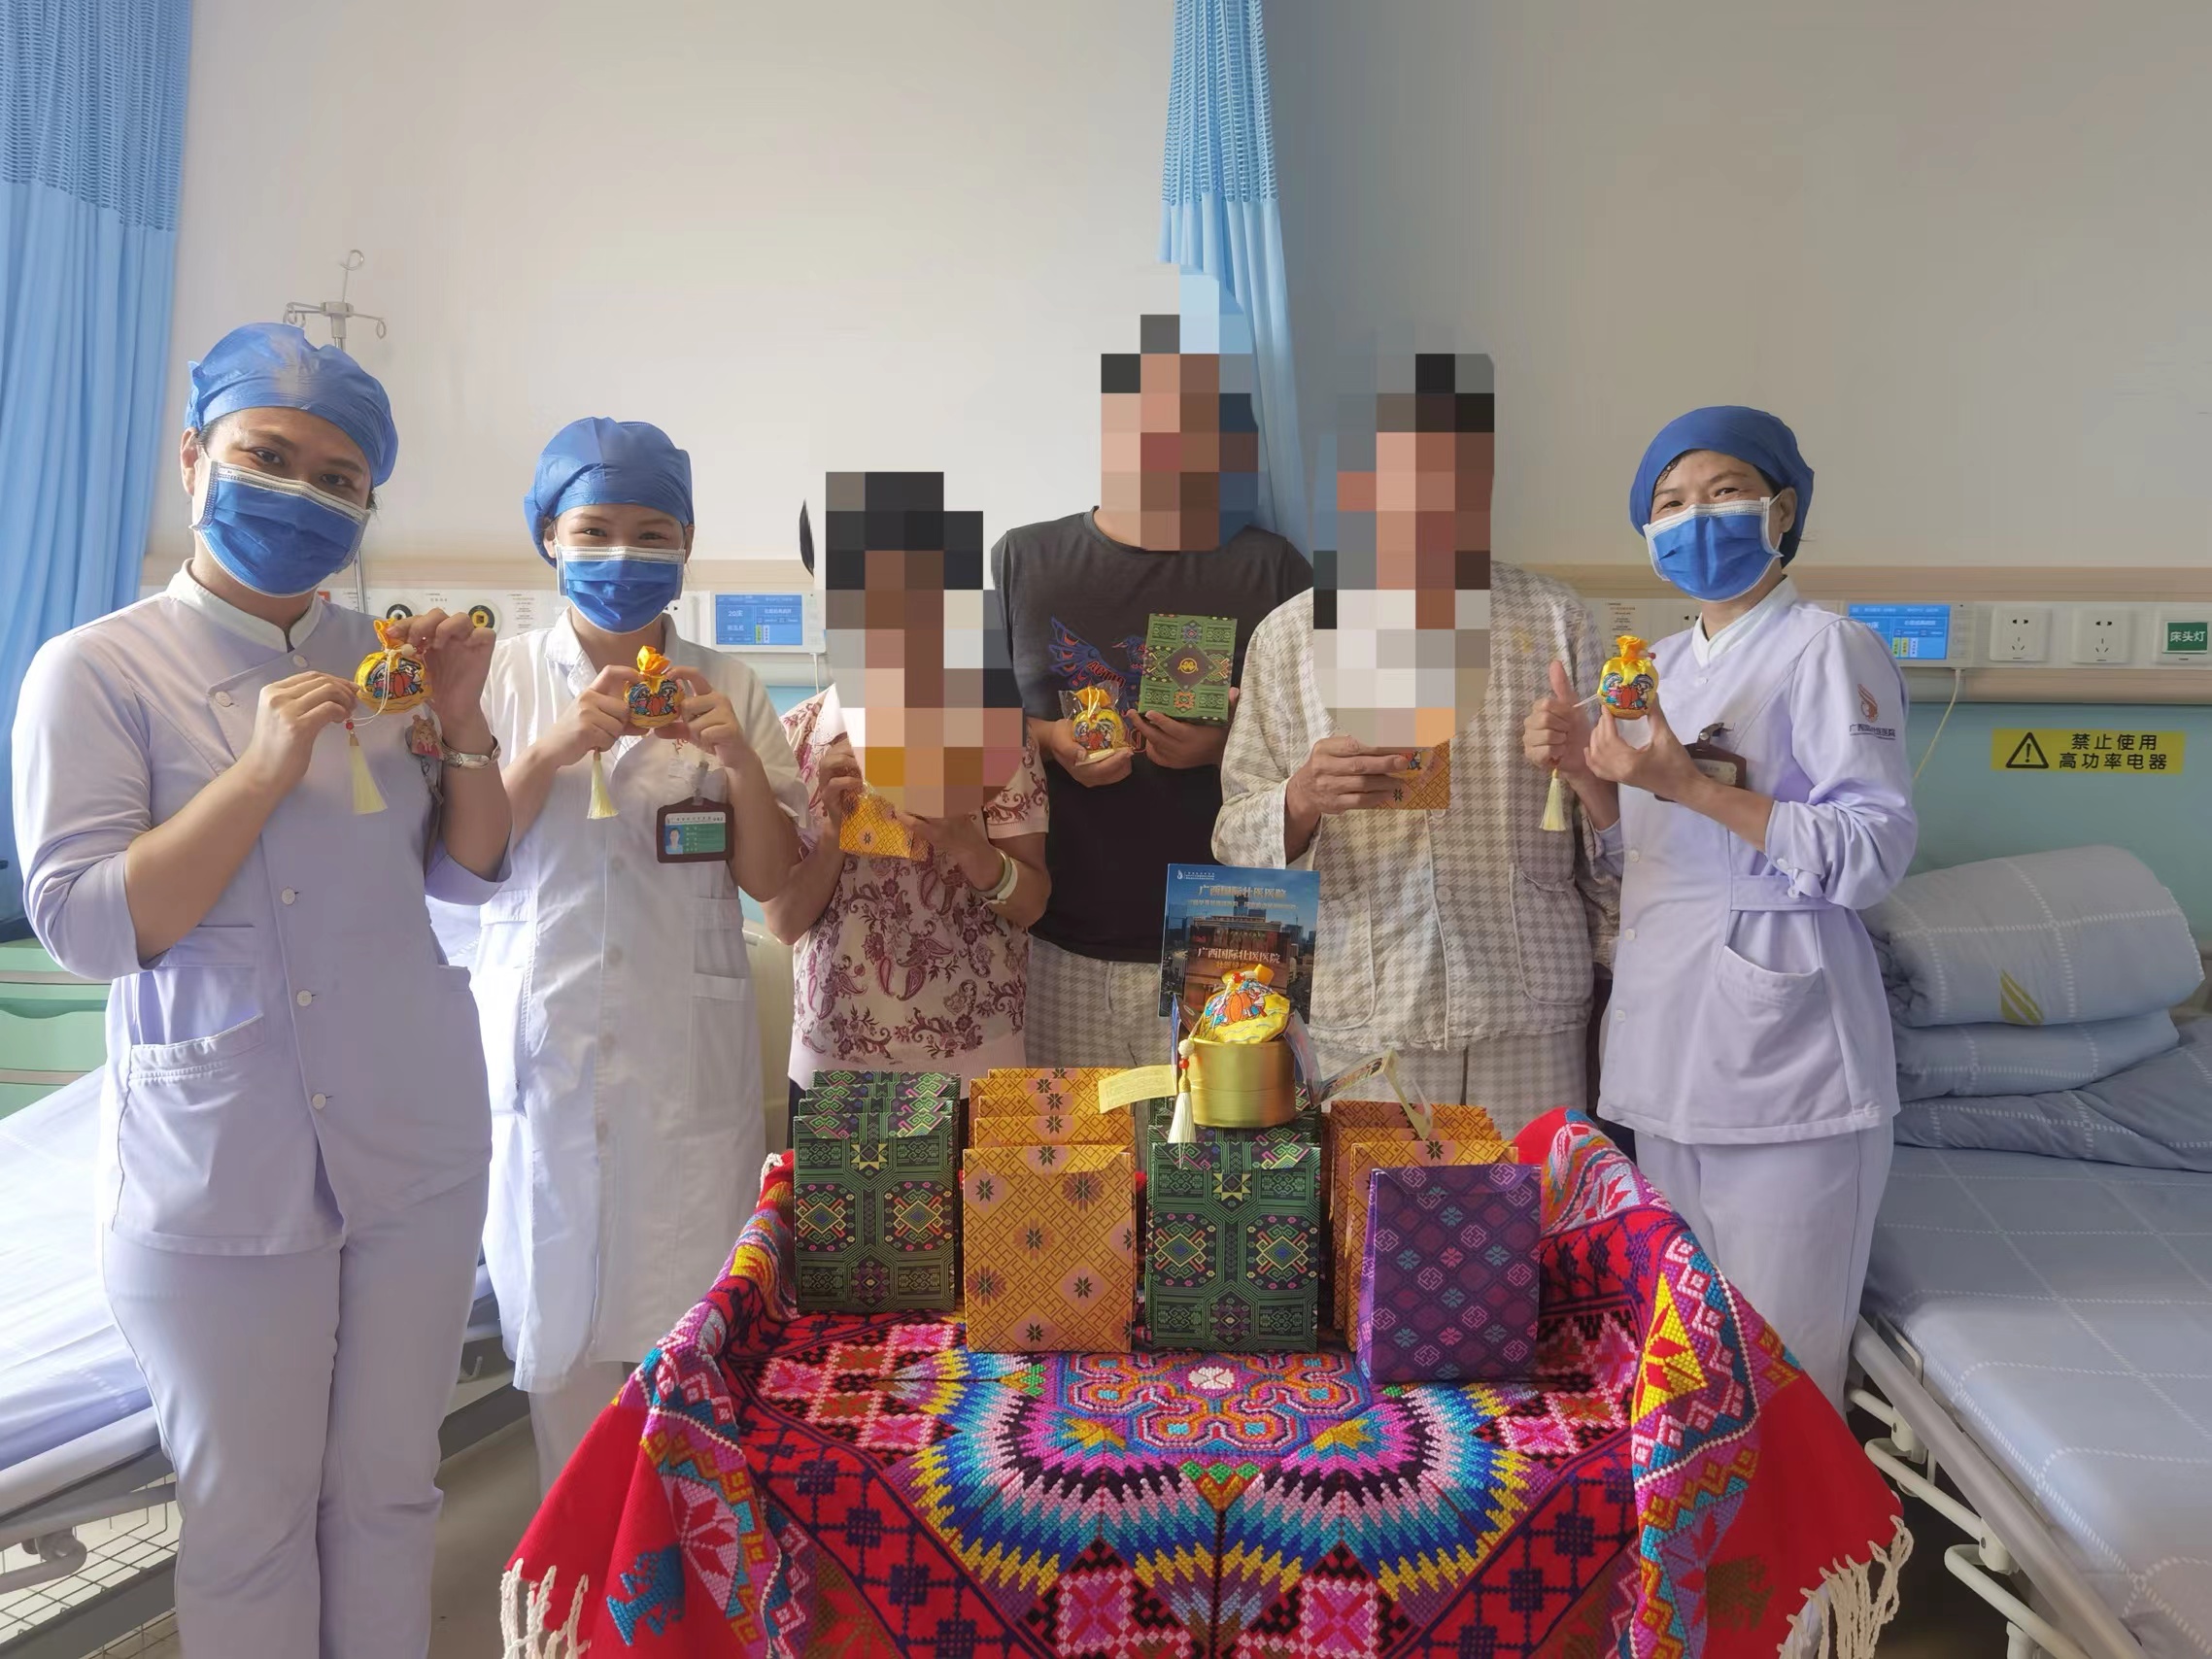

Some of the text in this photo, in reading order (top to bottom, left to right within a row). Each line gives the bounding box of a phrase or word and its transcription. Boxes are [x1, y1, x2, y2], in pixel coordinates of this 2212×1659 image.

[2170, 630, 2206, 642] 床头灯
[2071, 733, 2158, 751] 禁止使用
[2059, 753, 2167, 770] 高功率电器
[1198, 946, 1281, 965] 广西国际壮医医院
